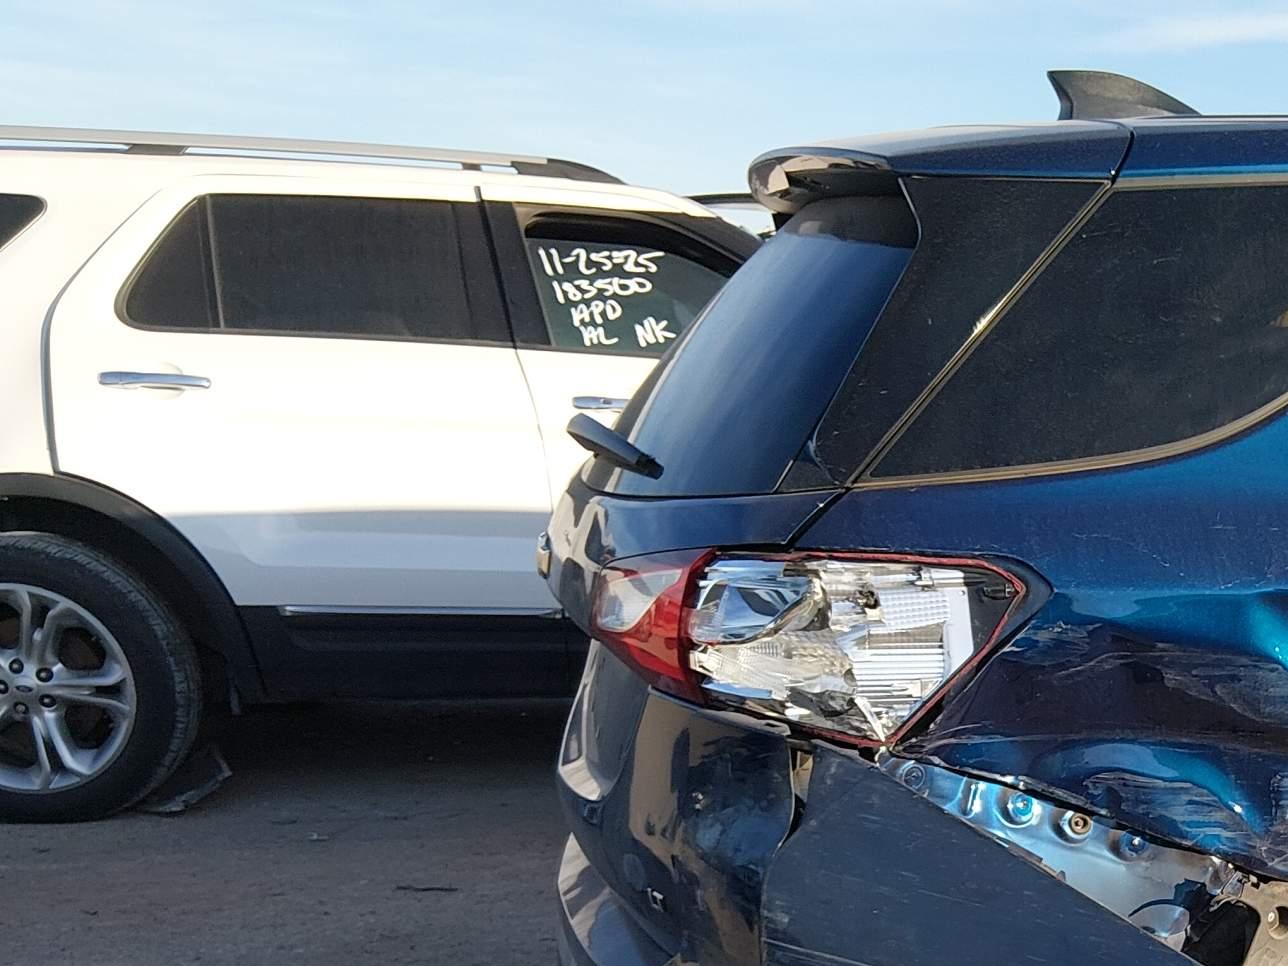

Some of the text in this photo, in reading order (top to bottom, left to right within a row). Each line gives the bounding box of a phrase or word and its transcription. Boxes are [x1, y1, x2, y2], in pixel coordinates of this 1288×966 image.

[551, 276, 653, 304] 183500
[634, 316, 677, 348] NK
[647, 887, 665, 913] LT
